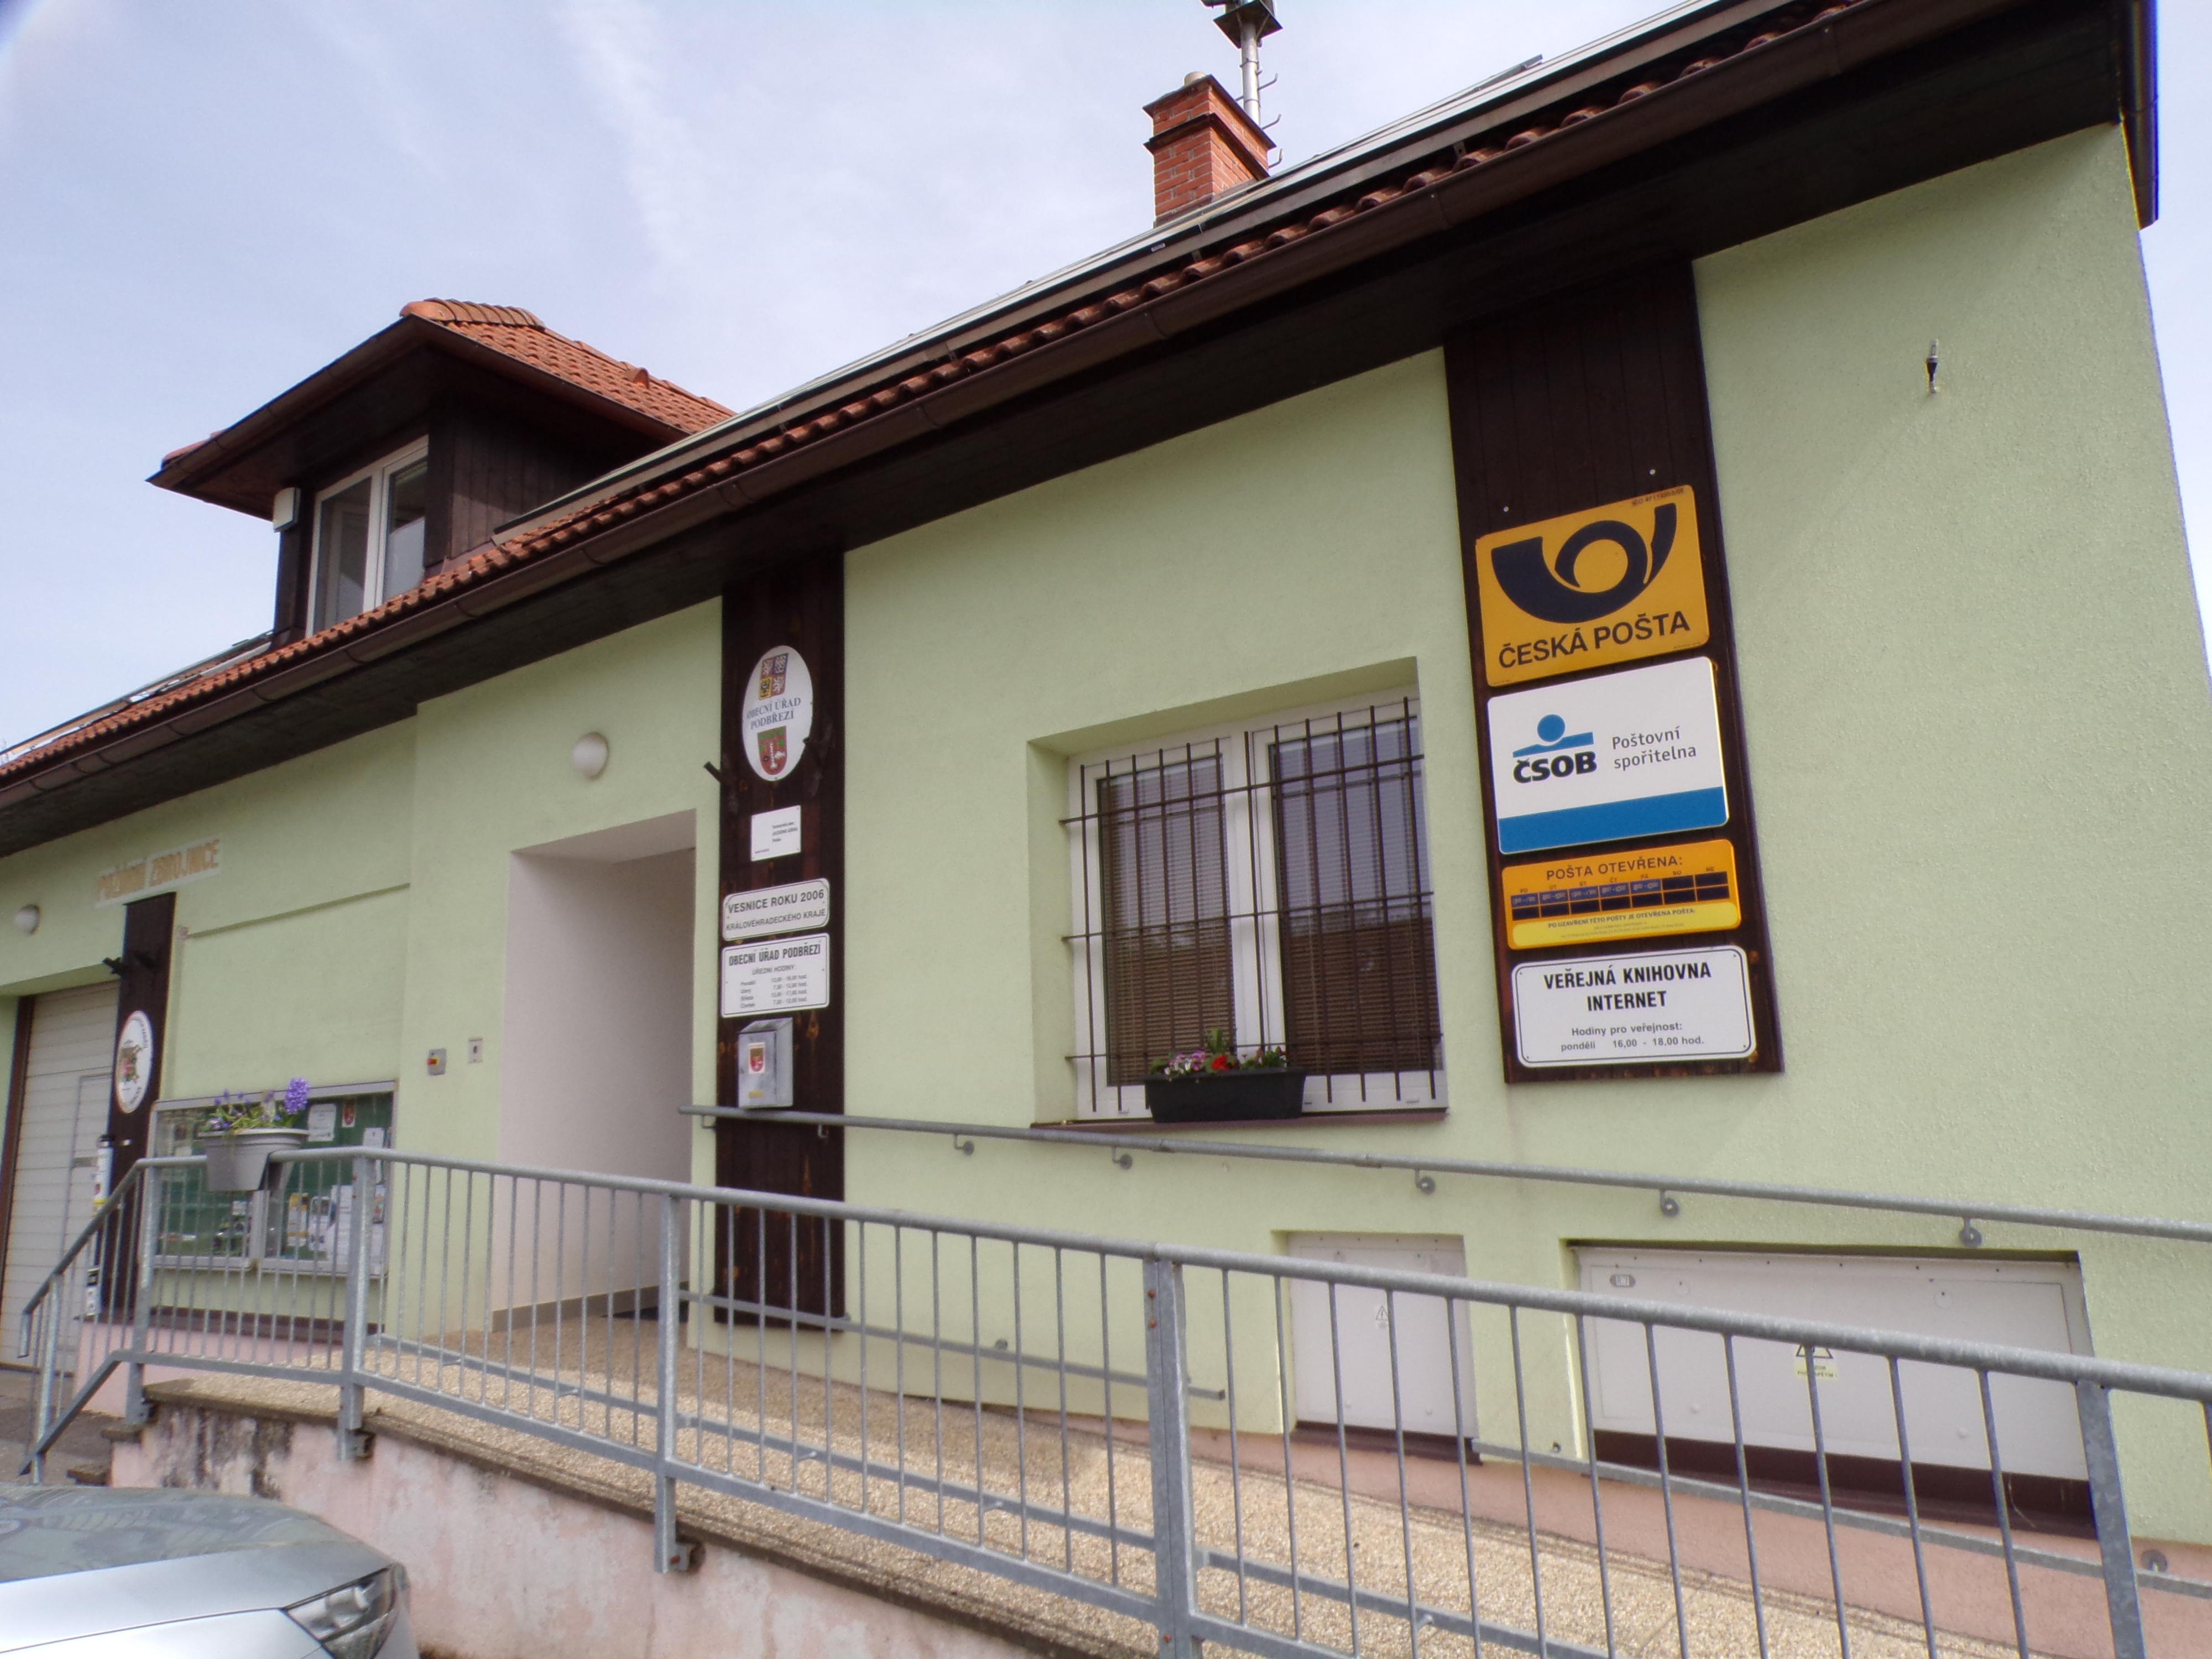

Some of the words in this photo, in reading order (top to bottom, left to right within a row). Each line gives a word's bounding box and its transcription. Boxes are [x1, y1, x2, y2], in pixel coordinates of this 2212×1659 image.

[1499, 628, 1587, 669] ČESKÁ
[1594, 611, 1690, 649] POŠTA
[747, 700, 772, 719] OBECNÍ
[751, 708, 794, 729] PODBŘEZÍ
[1612, 726, 1680, 750] Poštovní
[1513, 751, 1598, 784] ČSOB
[1614, 745, 1697, 771] spořitelna
[1547, 865, 1593, 881] POŠTA
[1598, 855, 1682, 874] OTEVŘENA:
[728, 899, 768, 913] VESNICE
[771, 894, 797, 906] ROKU
[801, 889, 824, 902] 2006
[726, 912, 801, 930] KRÁLOVÉHRADECKÉHO
[804, 909, 826, 919] KRAJE
[1636, 910, 1671, 919] OTEVŘENA
[729, 949, 756, 966] OBECNÍ
[759, 948, 779, 962] ÚŘAD
[783, 940, 821, 958] PODBŘEZÍ
[1544, 965, 1616, 989] VEŘEJNÁ
[1623, 962, 1712, 983] KNIHOVNA
[1587, 991, 1667, 1011] INTERNET
[1572, 1025, 1606, 1036] Hodiny
[1610, 1027, 1626, 1036] pro
[1631, 1022, 1682, 1034] veřejnost:
[1613, 1039, 1637, 1049] 16,00
[1652, 1037, 1678, 1047] 18,00
[1682, 1035, 1704, 1045] hod.
